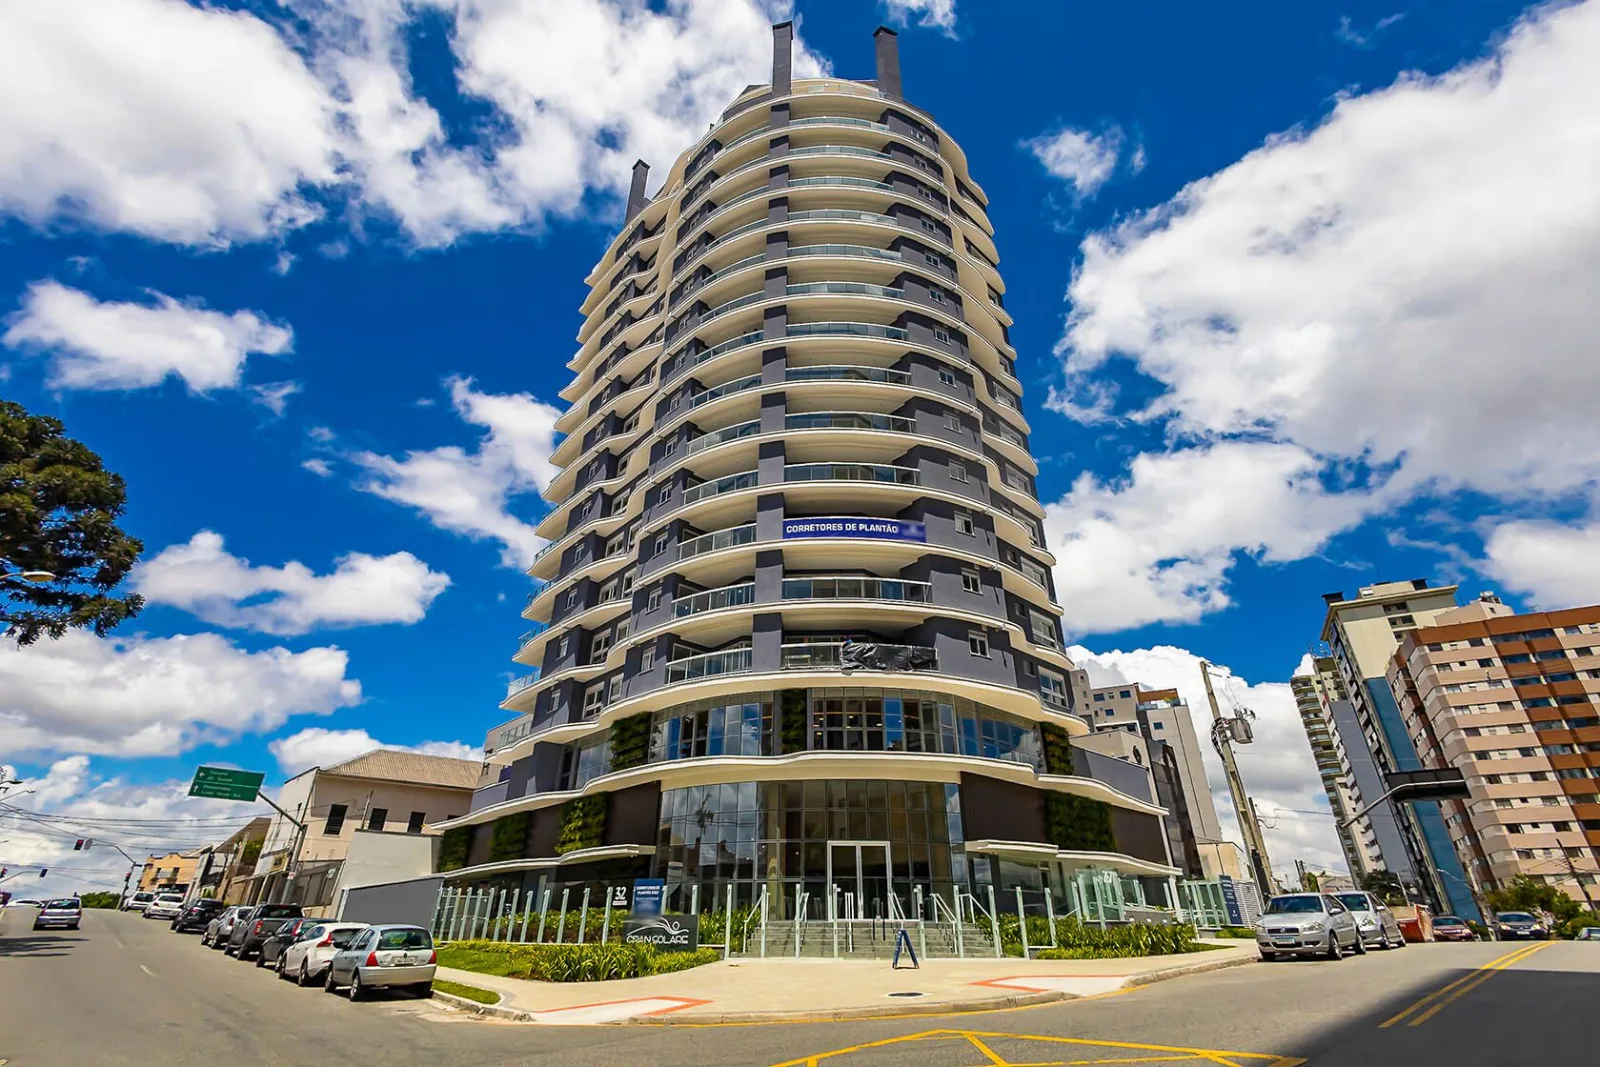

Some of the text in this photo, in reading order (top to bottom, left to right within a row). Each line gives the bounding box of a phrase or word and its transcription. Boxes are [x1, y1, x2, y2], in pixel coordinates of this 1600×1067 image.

[786, 523, 898, 533] CORRETORES DE PLANTÃO
[615, 886, 627, 900] 32
[652, 935, 689, 944] SOLARE
